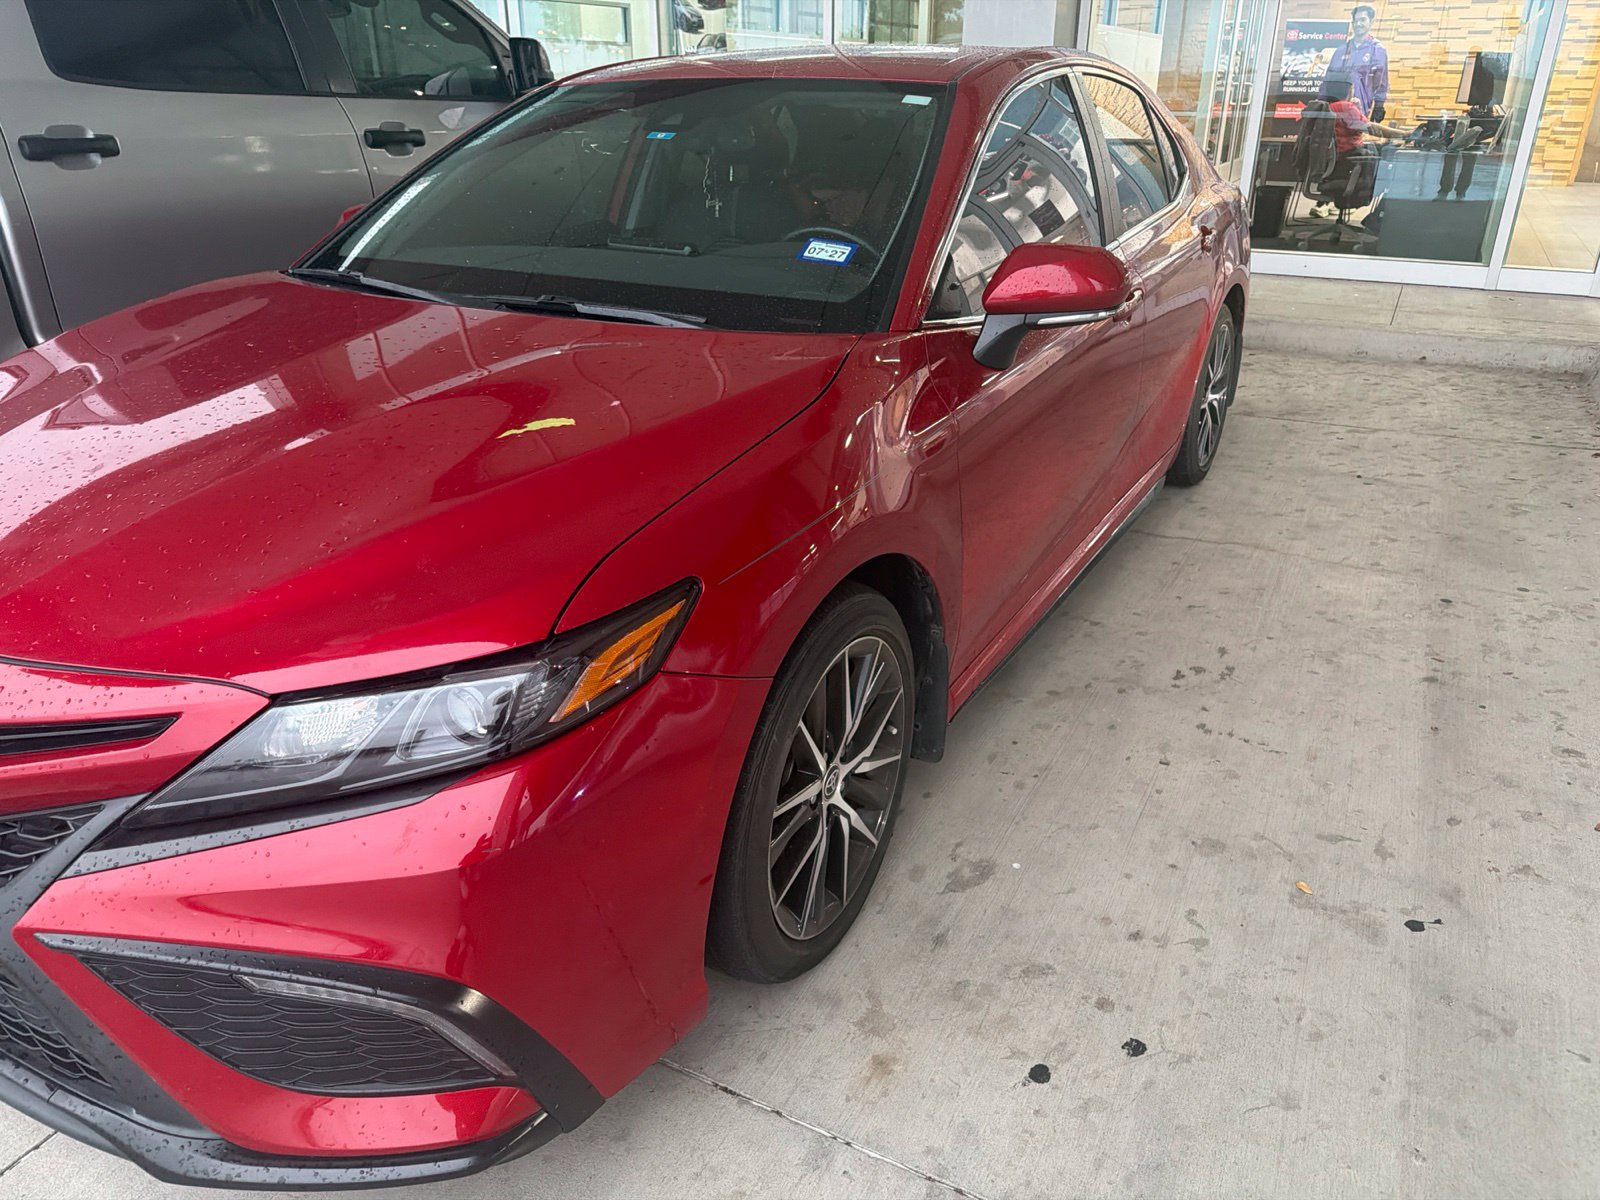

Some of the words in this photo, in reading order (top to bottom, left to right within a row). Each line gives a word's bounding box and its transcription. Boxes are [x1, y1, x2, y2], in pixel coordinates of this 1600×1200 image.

[1298, 32, 1323, 40] Service
[1324, 32, 1347, 40] Center
[807, 247, 825, 256] 07
[829, 249, 847, 259] 27
